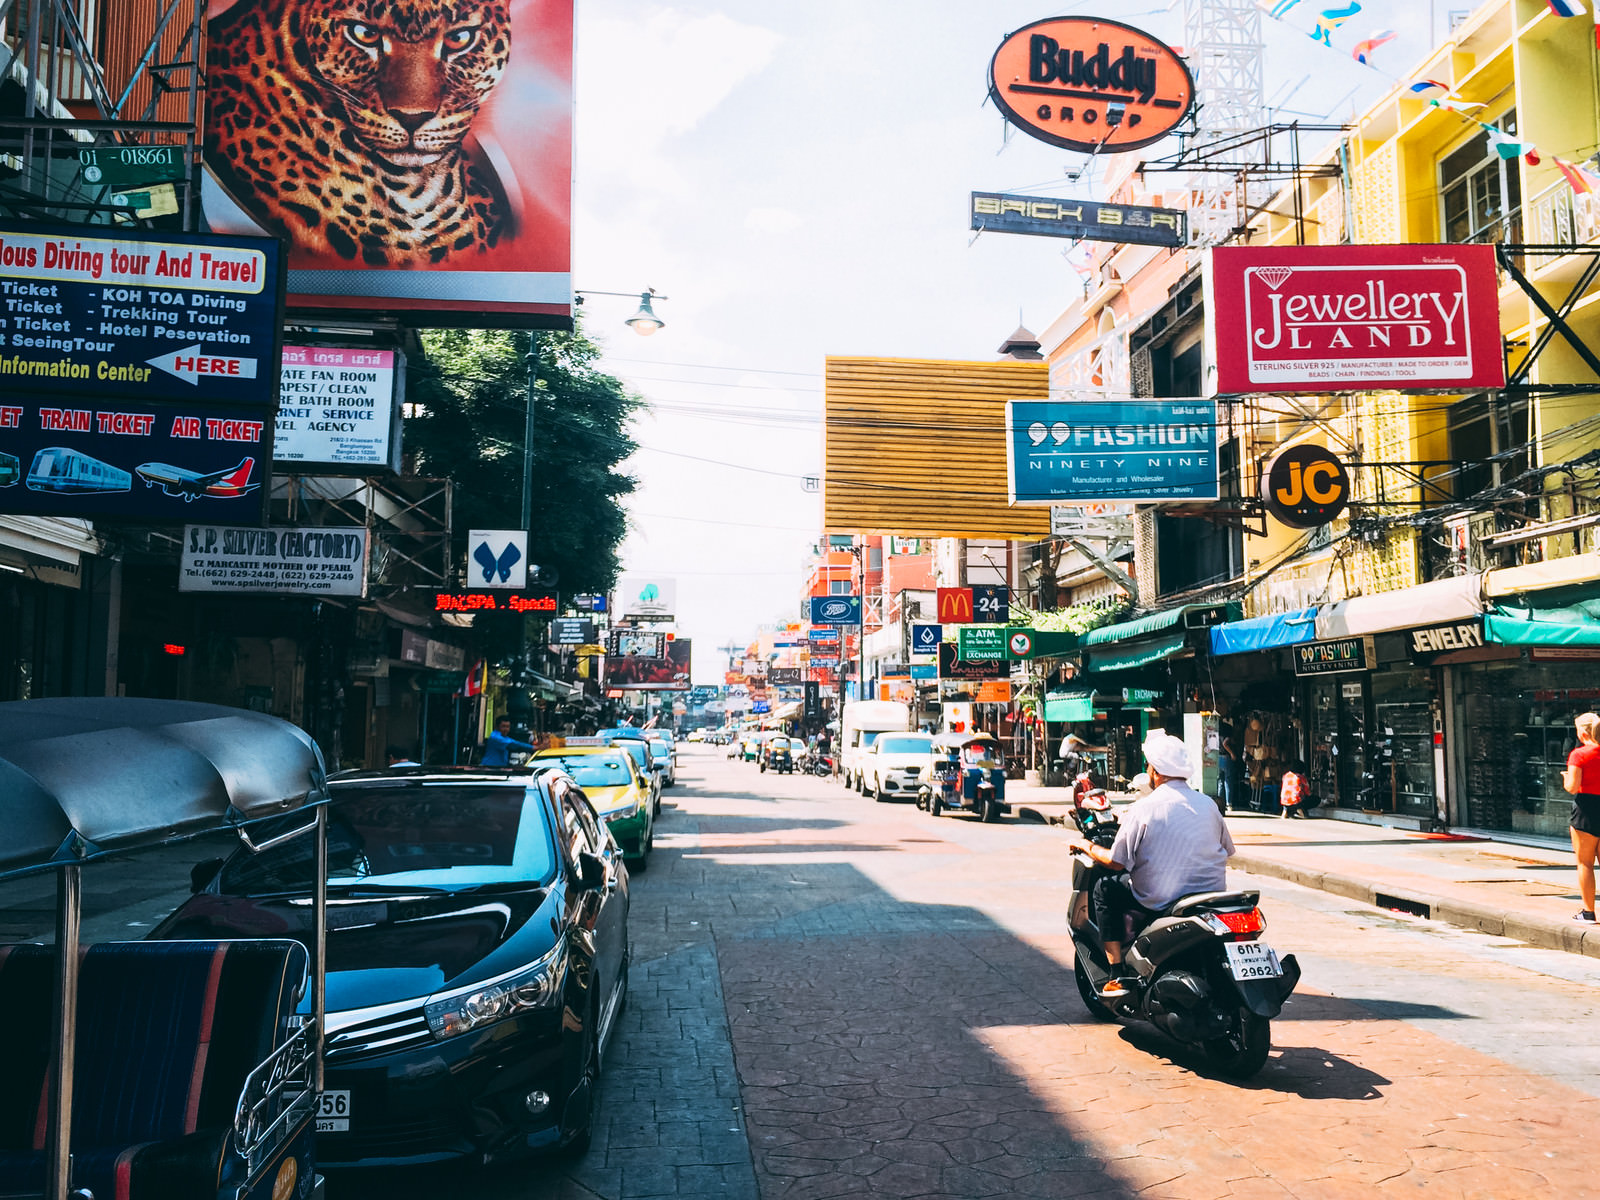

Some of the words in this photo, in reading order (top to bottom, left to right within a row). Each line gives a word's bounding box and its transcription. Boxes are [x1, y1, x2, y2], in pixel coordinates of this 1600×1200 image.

[1029, 33, 1157, 104] Buddy
[1036, 104, 1142, 128] GROP
[121, 148, 172, 165] 018661
[974, 197, 1083, 222] BRICK
[44, 241, 104, 279] Diving
[110, 248, 150, 275] tour
[155, 250, 192, 278] And
[200, 253, 257, 283] Travel
[1, 281, 58, 297] Ticket
[6, 299, 63, 315] Ticket
[102, 288, 142, 303] KOH
[149, 291, 185, 306] TOA
[191, 294, 246, 313] Diving
[101, 305, 179, 325] Trekking
[187, 310, 228, 325] Tour
[13, 316, 71, 333] Ticket
[100, 322, 147, 337] Hotel
[153, 326, 251, 344] Pesevation
[1289, 325, 1432, 349] LAND
[97, 360, 151, 382] Center
[175, 356, 240, 375] HERE
[1254, 363, 1291, 371] STERLING
[1320, 361, 1335, 369] 925
[311, 371, 334, 381] FAN
[340, 372, 376, 382] ROOM
[328, 384, 367, 394] CLEAN
[299, 396, 332, 406] BATH
[337, 398, 374, 408] ROOM
[322, 409, 374, 420] SERVICE
[39, 407, 91, 432] TRAIN
[97, 411, 155, 436] TICKET
[170, 416, 201, 439] AIR
[206, 418, 263, 442] TICKET
[307, 421, 357, 433] AGENCY
[1027, 421, 1071, 447] 99
[1073, 423, 1208, 446] FASHION
[1029, 459, 1125, 470] NINETY
[1148, 457, 1208, 467] NINE
[1276, 460, 1342, 507] JC
[223, 529, 277, 556] SILVER
[280, 531, 361, 562] (FACTORY)
[207, 560, 259, 569] MARCASITE
[263, 562, 303, 571] MOTHER
[321, 564, 352, 572] PEARL
[211, 580, 331, 589] www.spsilverjewelry.com
[281, 571, 306, 580] (622)
[309, 573, 354, 581] 629-2449
[979, 597, 1000, 612] 24
[975, 629, 996, 638] ATM
[1412, 624, 1483, 652] JEWELRY
[966, 651, 1002, 659] EXCHANGE
[1315, 641, 1357, 661] FASHION
[1303, 664, 1333, 672] NINETY
[1338, 660, 1359, 668] NINE
[1241, 966, 1272, 977] 2962
